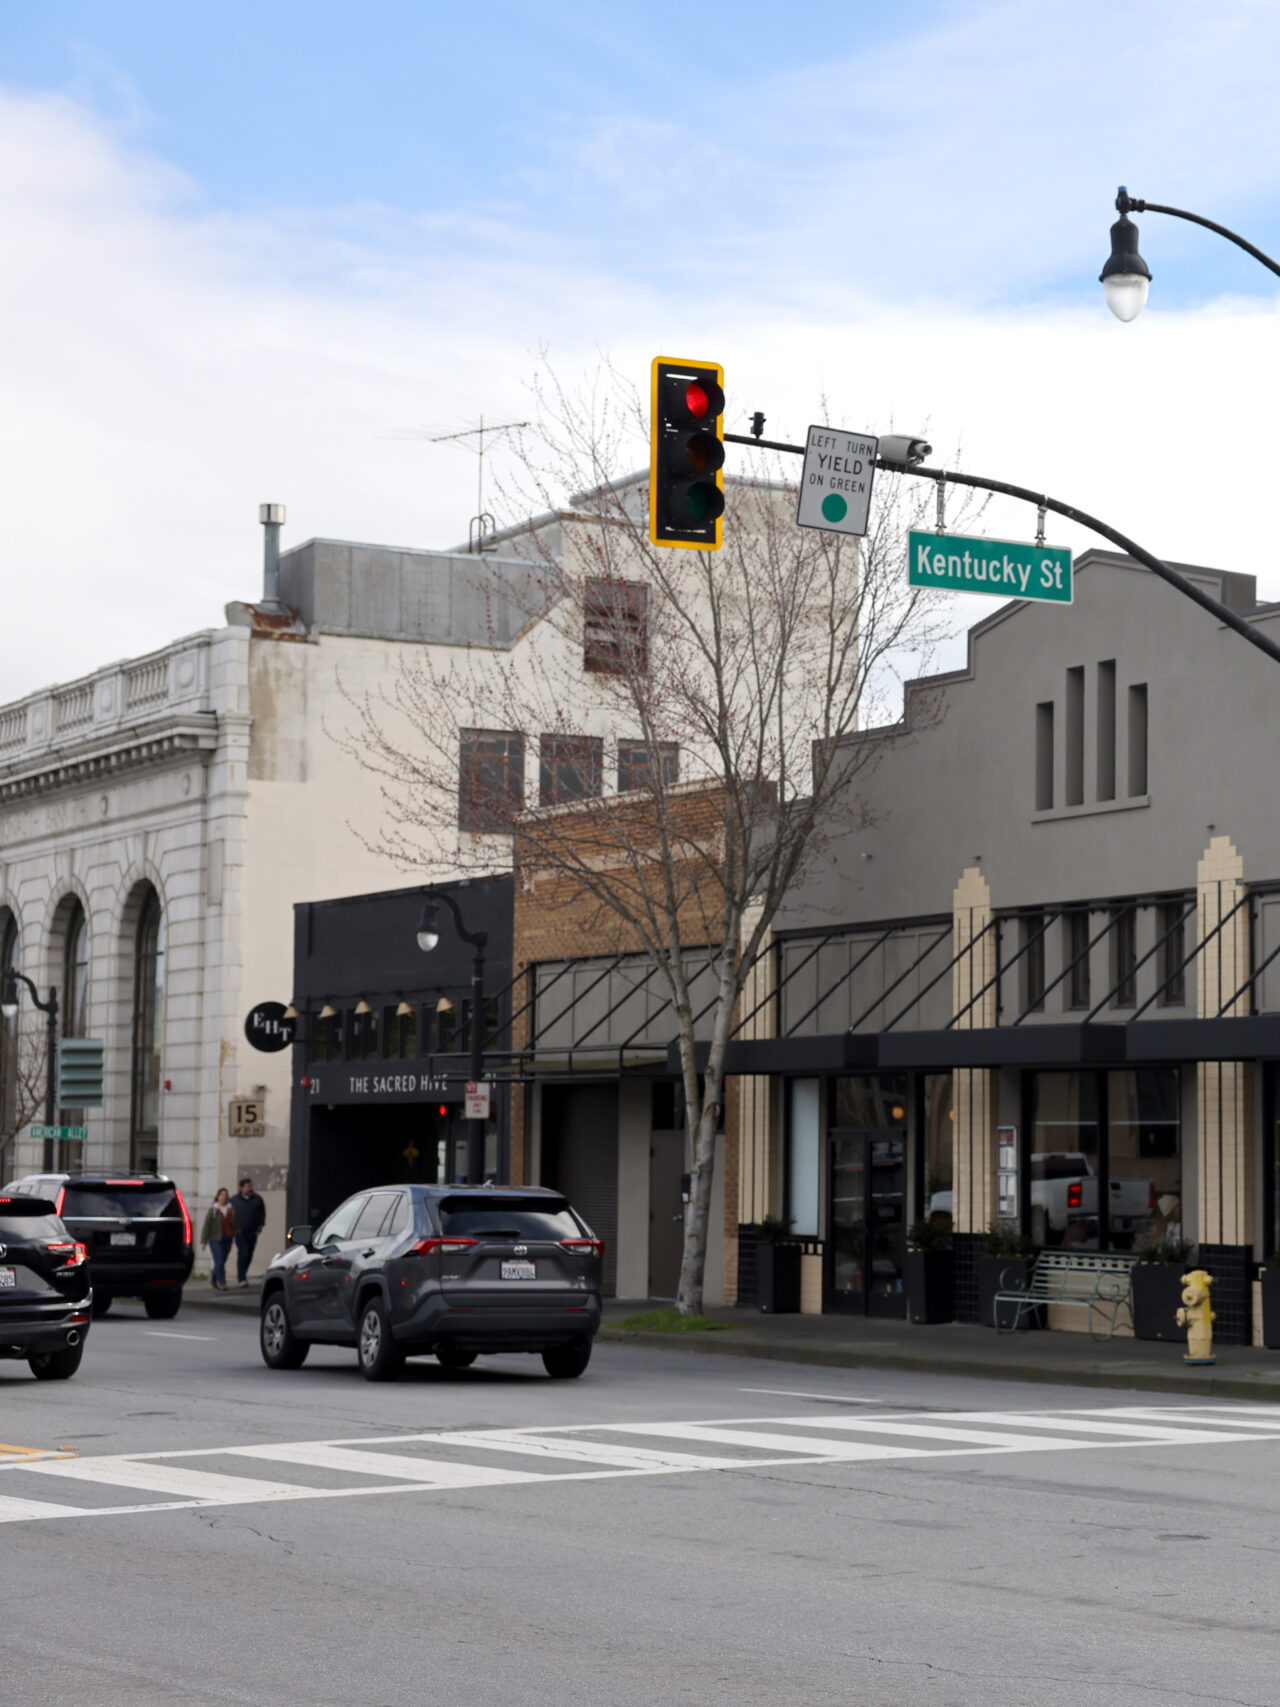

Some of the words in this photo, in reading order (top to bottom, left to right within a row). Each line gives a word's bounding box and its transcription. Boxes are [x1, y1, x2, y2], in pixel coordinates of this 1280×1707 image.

[811, 434, 837, 449] LEFT
[847, 441, 873, 456] TURN
[818, 453, 863, 475] YIELD
[809, 473, 824, 486] ON
[830, 477, 866, 493] GREEN
[917, 544, 1032, 592] Kentucky
[1039, 559, 1064, 589] St
[310, 1079, 320, 1094] 21
[350, 1077, 369, 1093] THE
[373, 1075, 416, 1092] SACRED
[237, 1104, 257, 1123] 15
[68, 1127, 87, 1139] ALLEY
